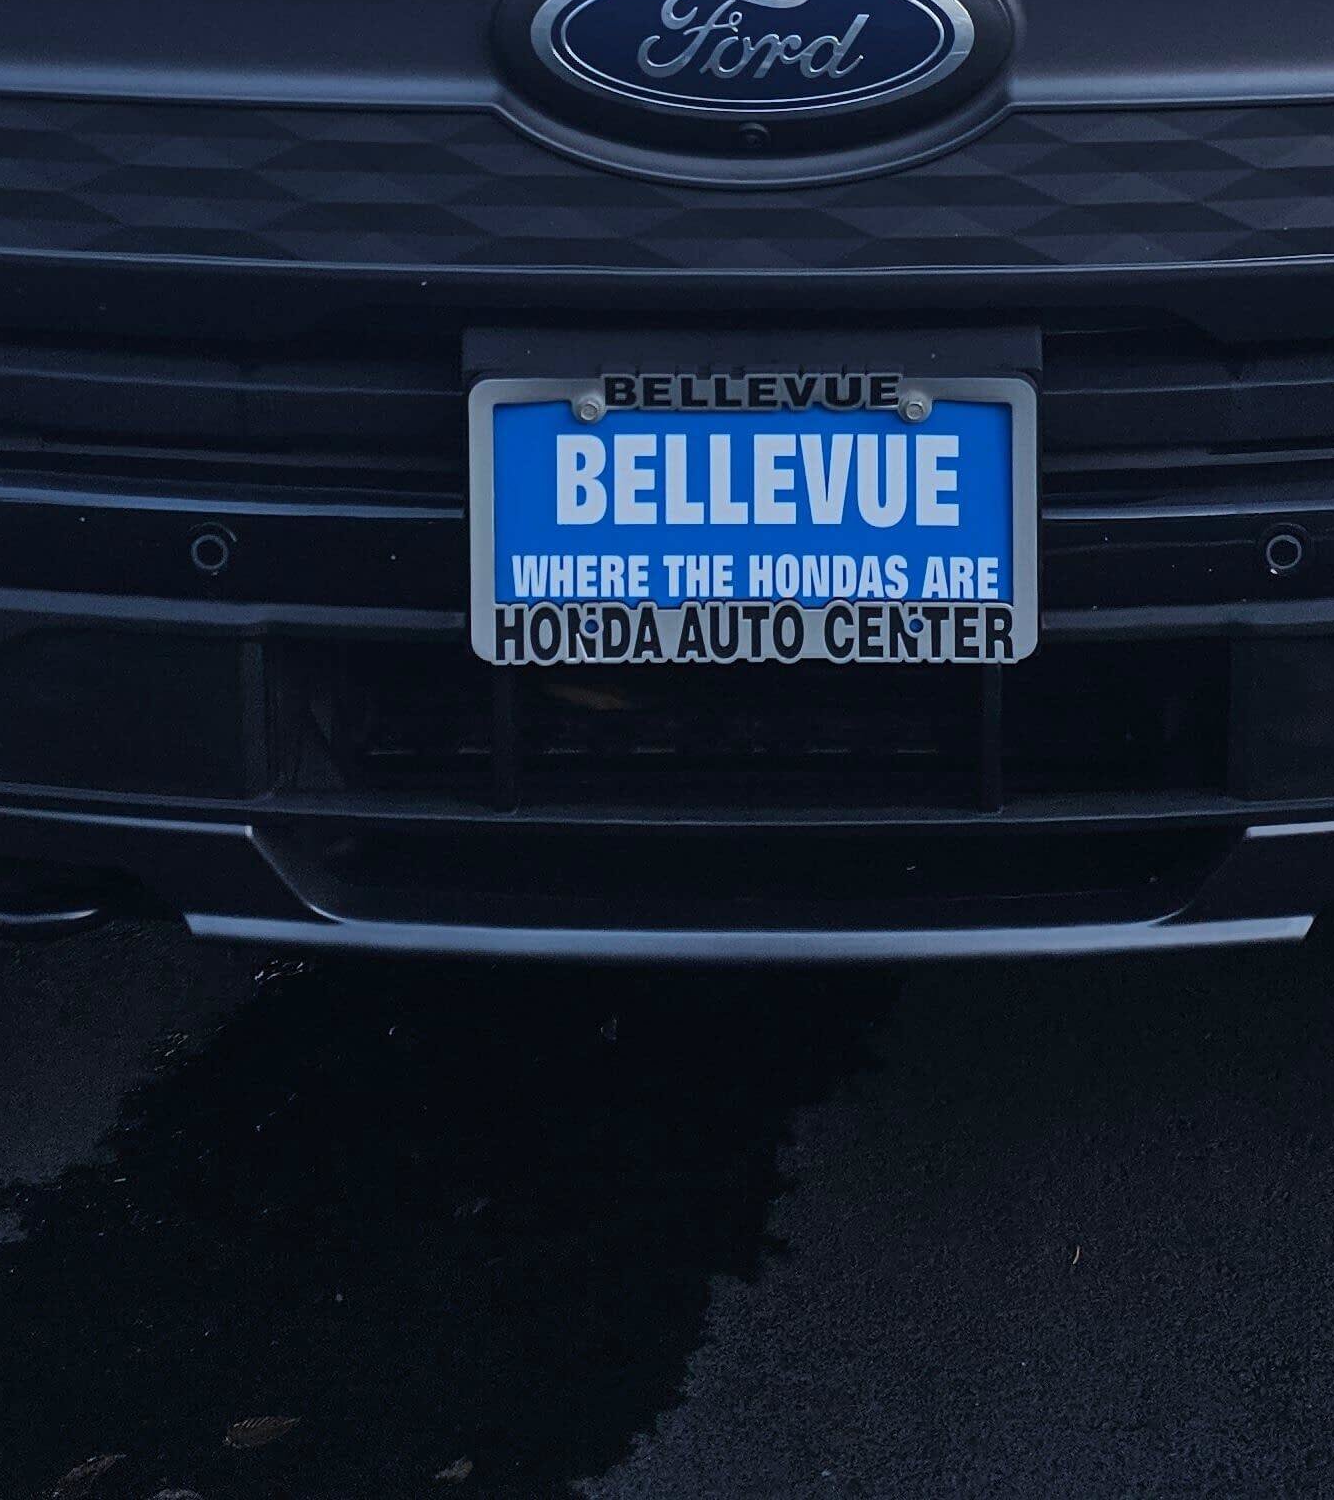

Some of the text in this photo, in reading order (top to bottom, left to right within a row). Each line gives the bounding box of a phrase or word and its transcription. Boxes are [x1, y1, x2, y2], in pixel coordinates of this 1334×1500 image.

[603, 374, 901, 410] BELLEVUE
[556, 434, 960, 527] BELLEVUE
[512, 555, 999, 600] WHERE THE HONDAS ARE
[494, 603, 1015, 663] HONDA AUTO CENTER
